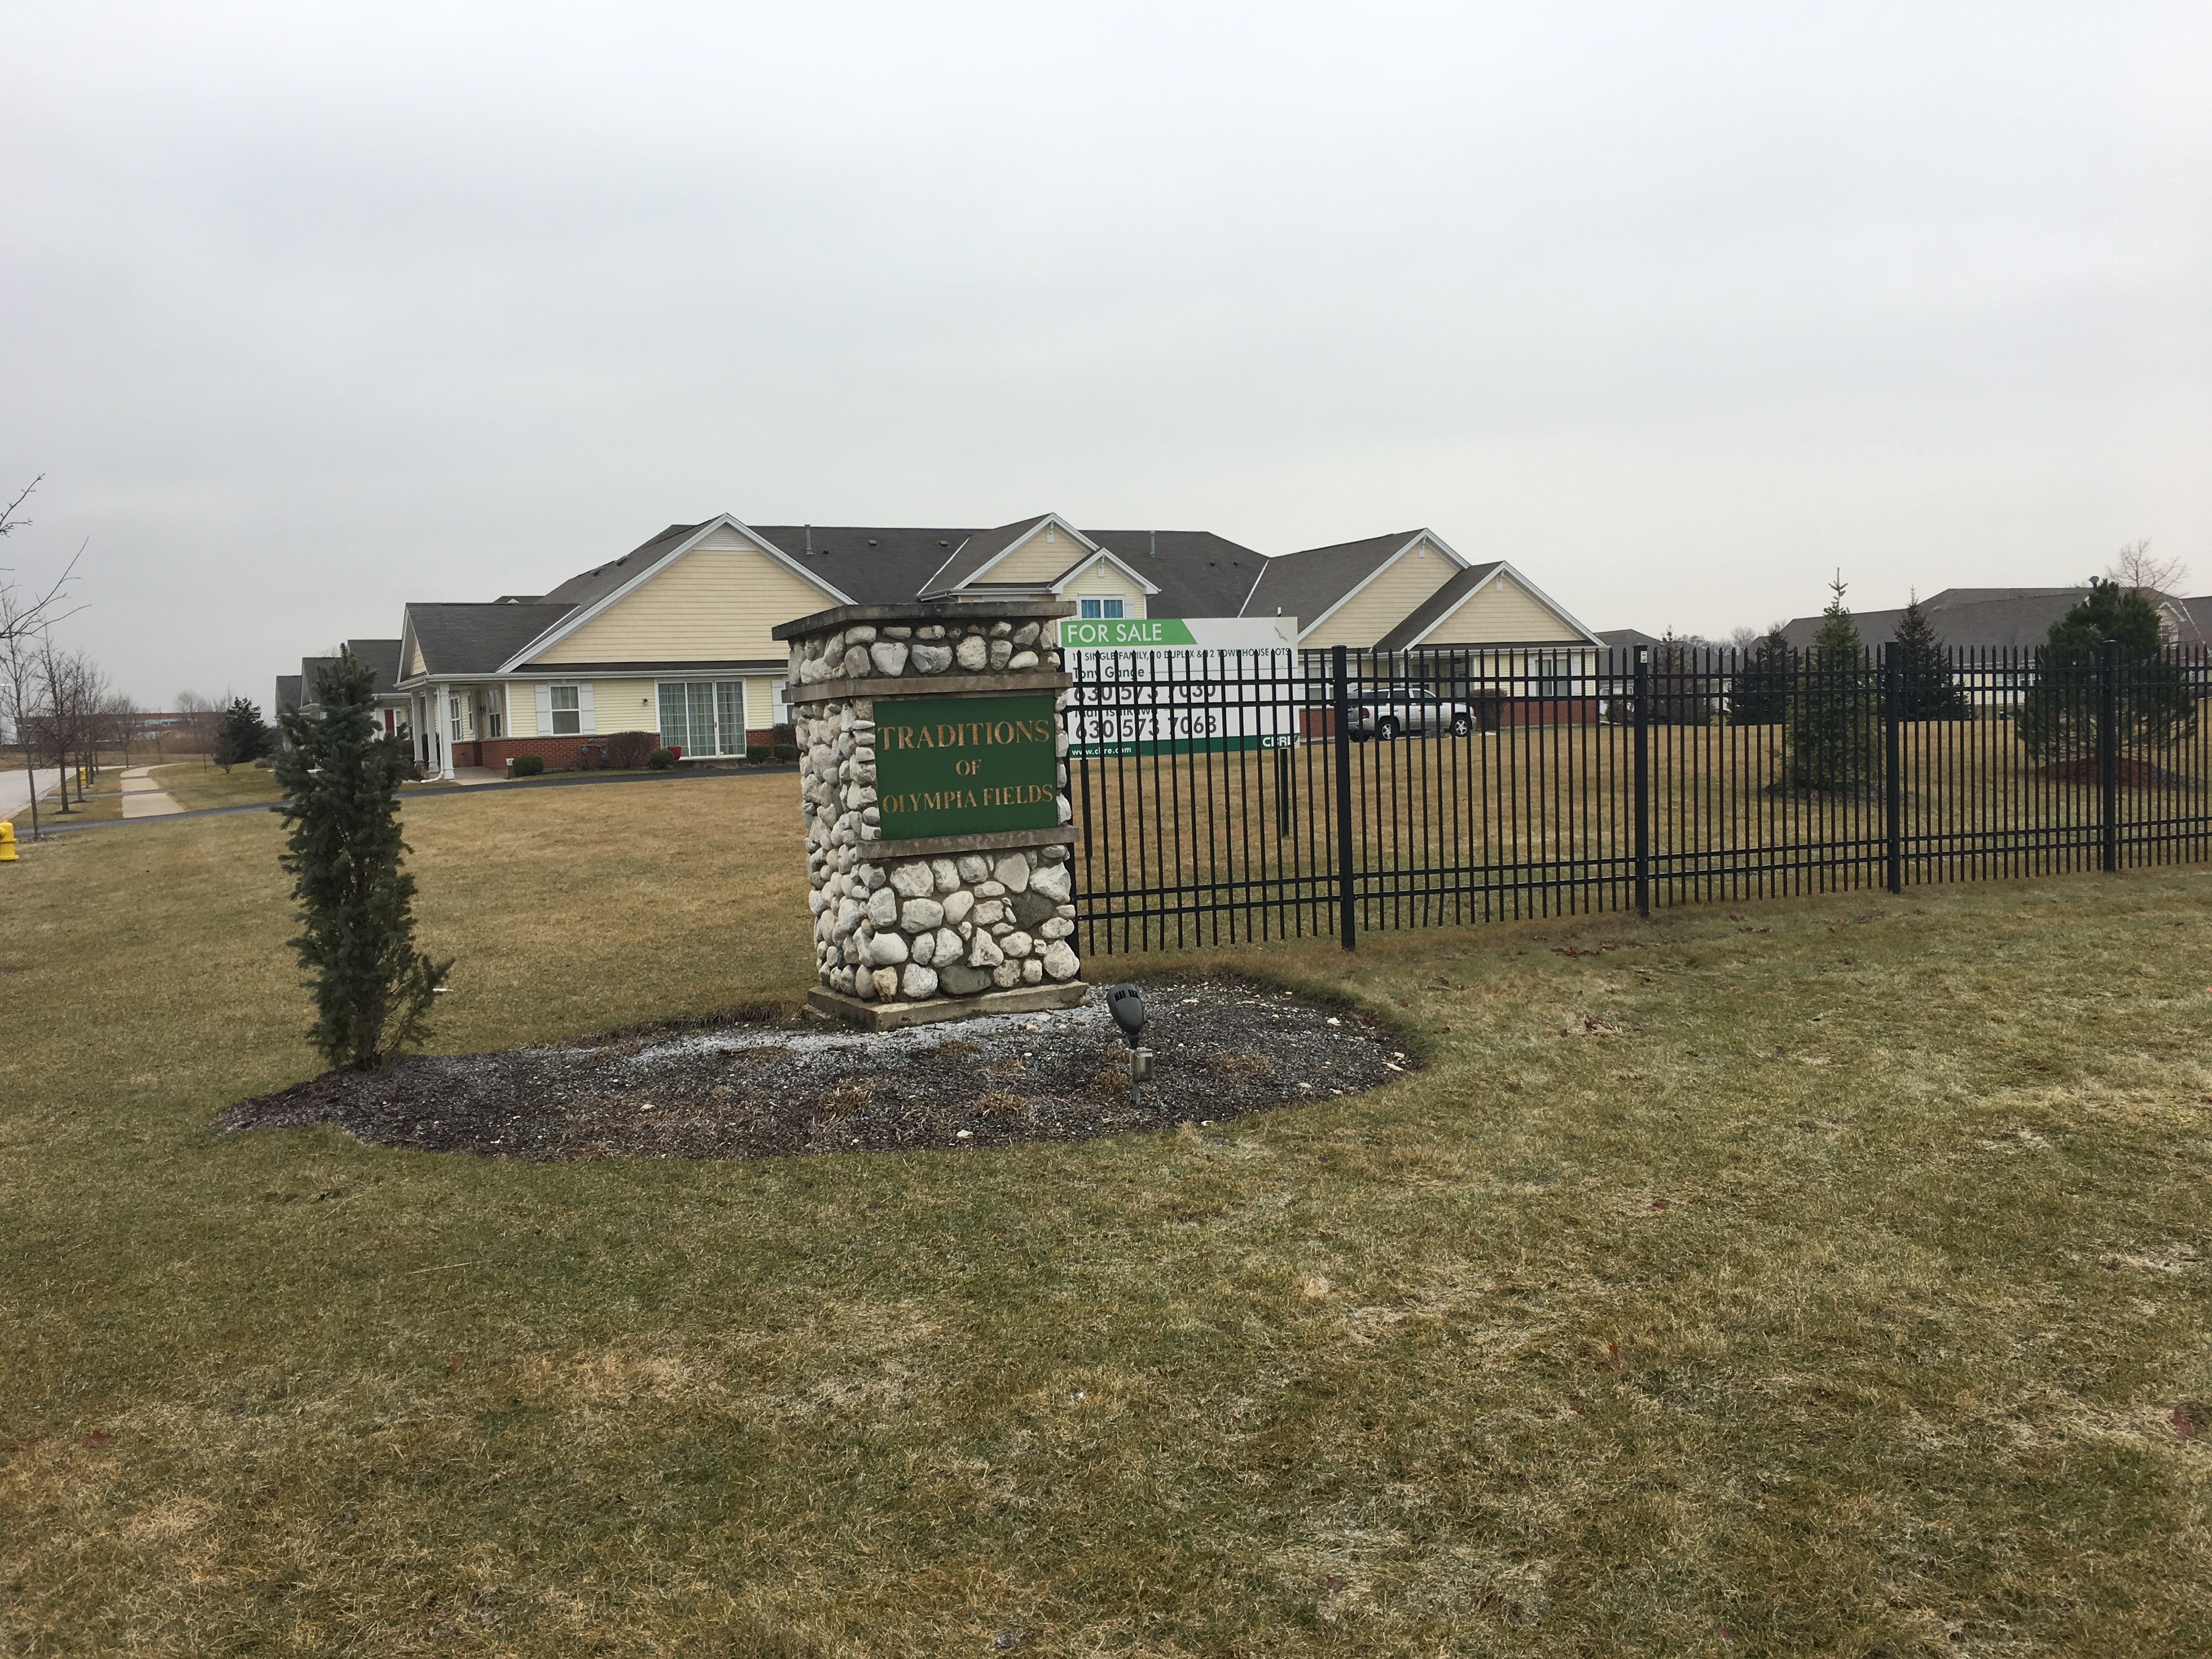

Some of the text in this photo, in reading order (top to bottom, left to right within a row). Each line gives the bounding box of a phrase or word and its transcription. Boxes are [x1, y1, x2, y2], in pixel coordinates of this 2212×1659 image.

[1068, 623, 1162, 643] FOR SALE
[1085, 652, 1115, 661] SINGLE
[1164, 650, 1194, 659] DUPLX
[1197, 650, 1203, 658] &
[1271, 647, 1290, 656] OTS
[1072, 667, 1101, 681] Tony
[1167, 679, 1216, 698] 030
[878, 719, 1050, 750] TRADITIONS
[1075, 715, 1217, 740] 630 573 7068
[1071, 746, 1132, 756] www.cre.cm
[956, 759, 981, 776] OF
[882, 784, 1053, 813] OLYMPIA FIELDS
